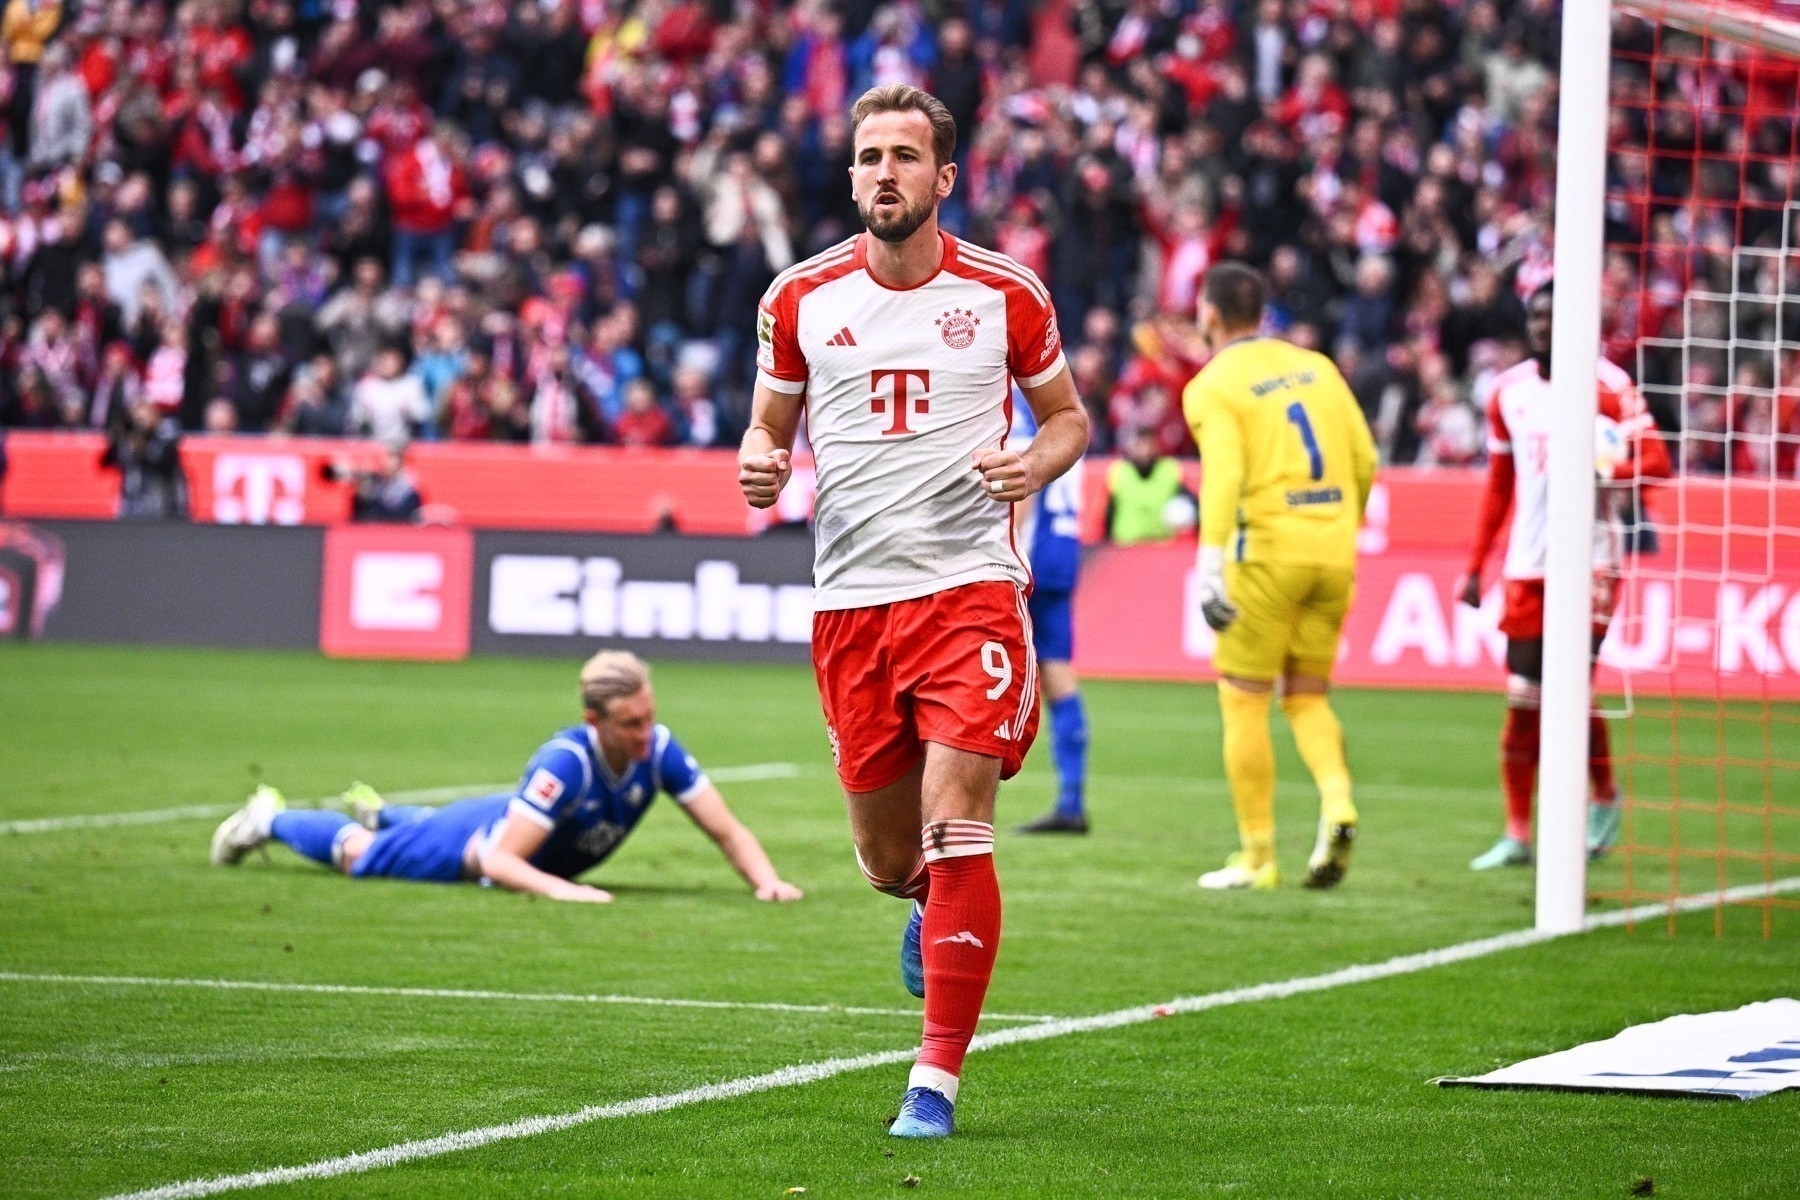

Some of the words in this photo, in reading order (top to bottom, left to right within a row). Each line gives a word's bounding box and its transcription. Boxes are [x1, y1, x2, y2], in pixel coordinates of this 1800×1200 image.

[871, 369, 930, 436] T
[1287, 402, 1323, 481] 1
[981, 640, 1012, 700] 9
